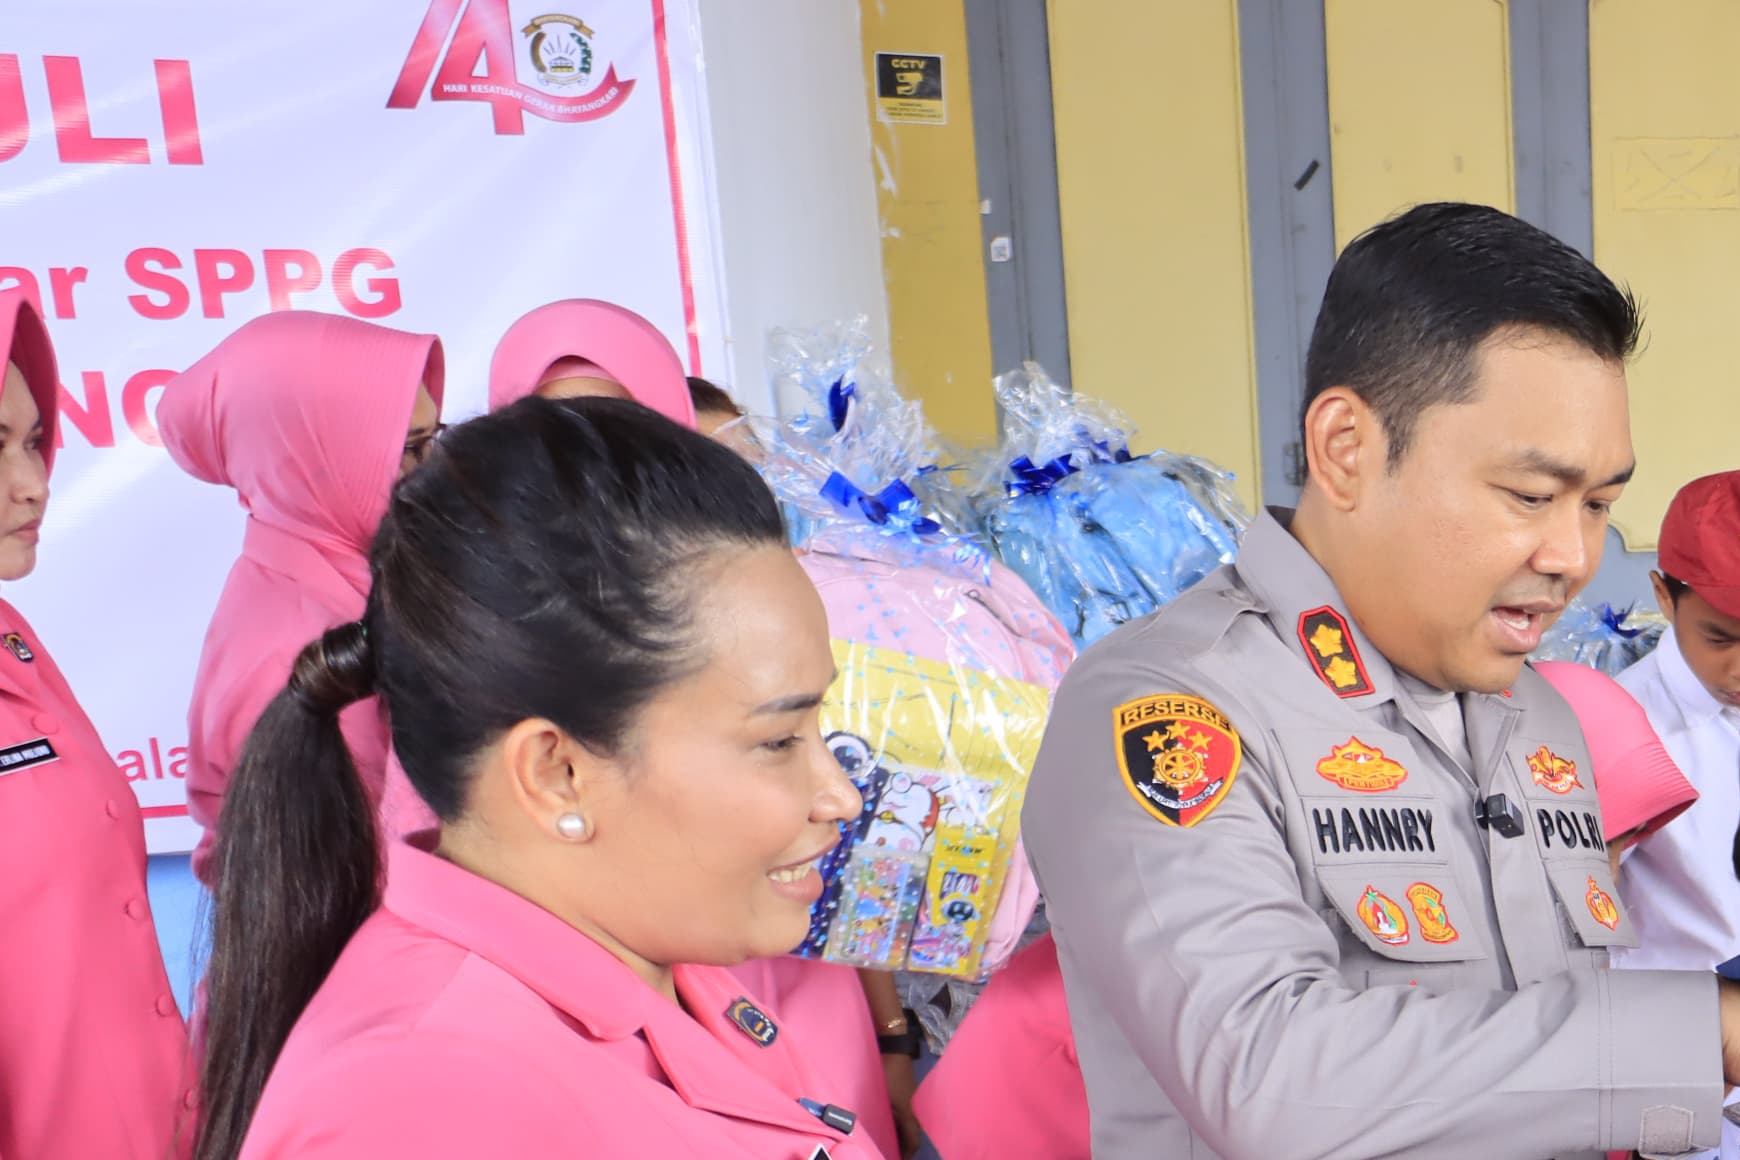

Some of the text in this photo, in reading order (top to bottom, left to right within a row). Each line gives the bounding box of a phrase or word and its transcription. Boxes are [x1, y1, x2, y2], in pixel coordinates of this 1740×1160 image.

[890, 58, 927, 70] CCTV
[442, 84, 468, 93] HARI
[470, 84, 523, 99] KESATUAN
[124, 247, 403, 320] SPPG
[1121, 700, 1231, 730] RESERSE
[1312, 807, 1436, 854] HANNRY
[1536, 808, 1605, 853] POLRI
